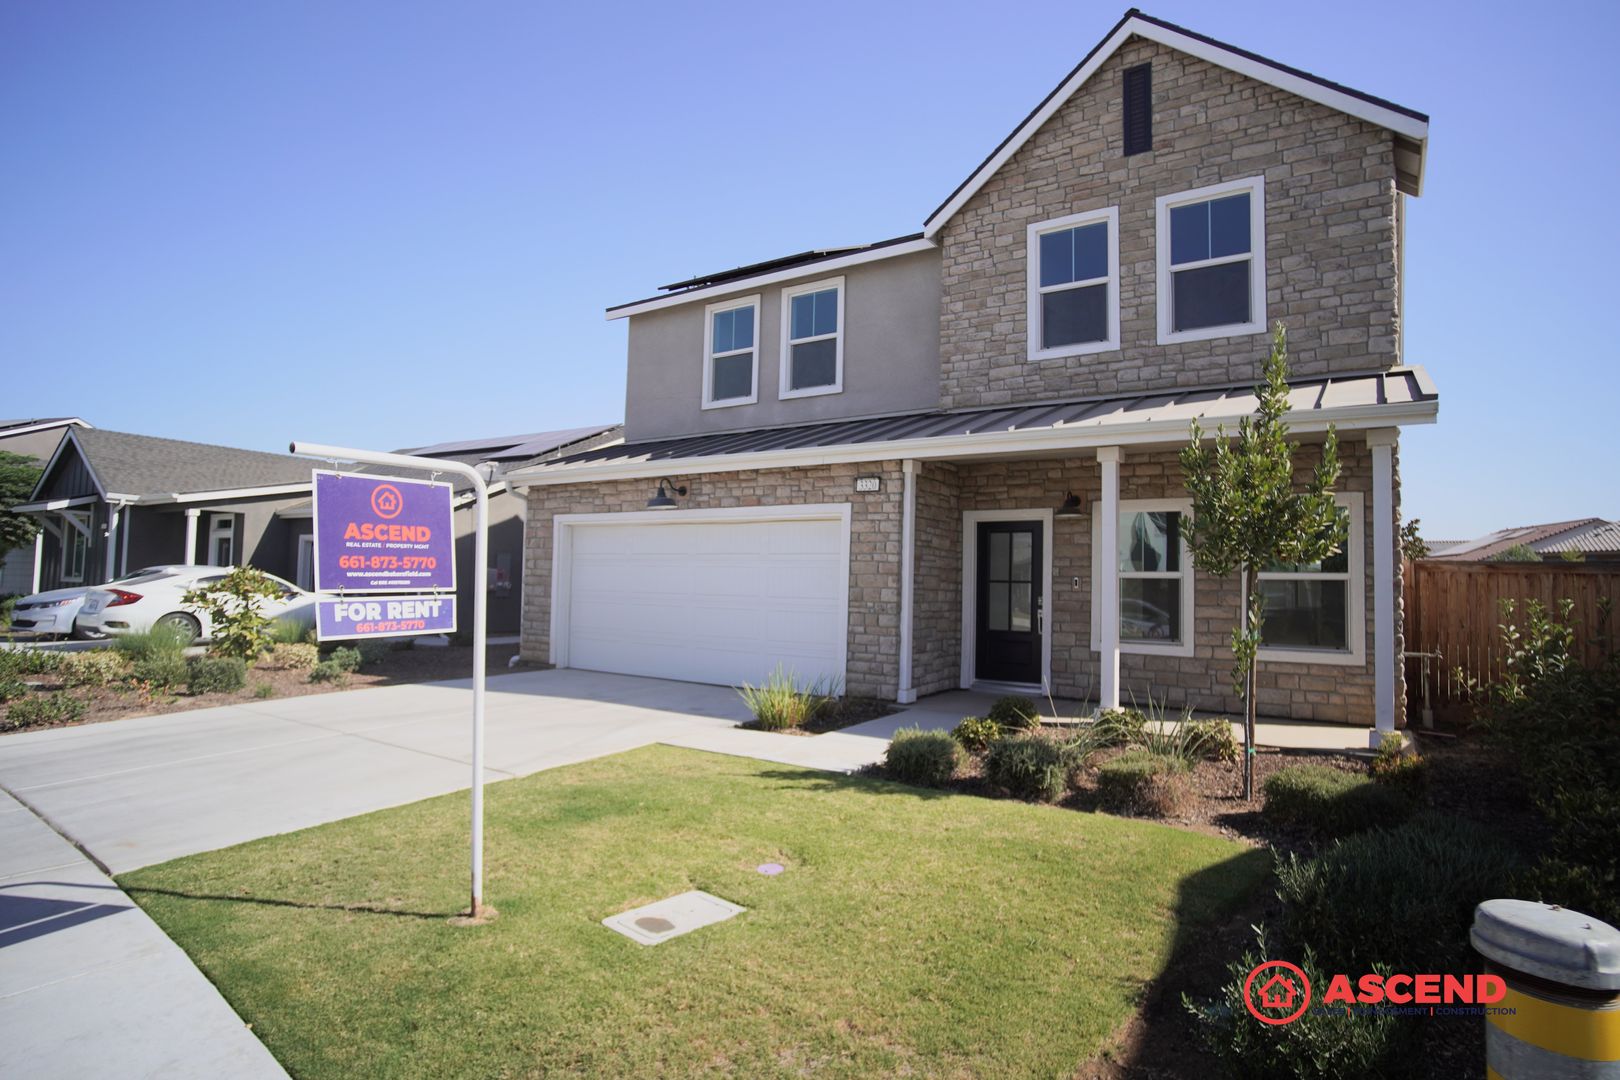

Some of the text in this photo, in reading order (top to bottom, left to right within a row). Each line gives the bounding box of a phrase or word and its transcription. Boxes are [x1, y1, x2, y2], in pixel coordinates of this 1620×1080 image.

[343, 522, 431, 543] ASCEND
[339, 555, 437, 569] 661-873-5770
[334, 599, 442, 623] FOR RENT
[355, 620, 425, 633] 661-873-5770
